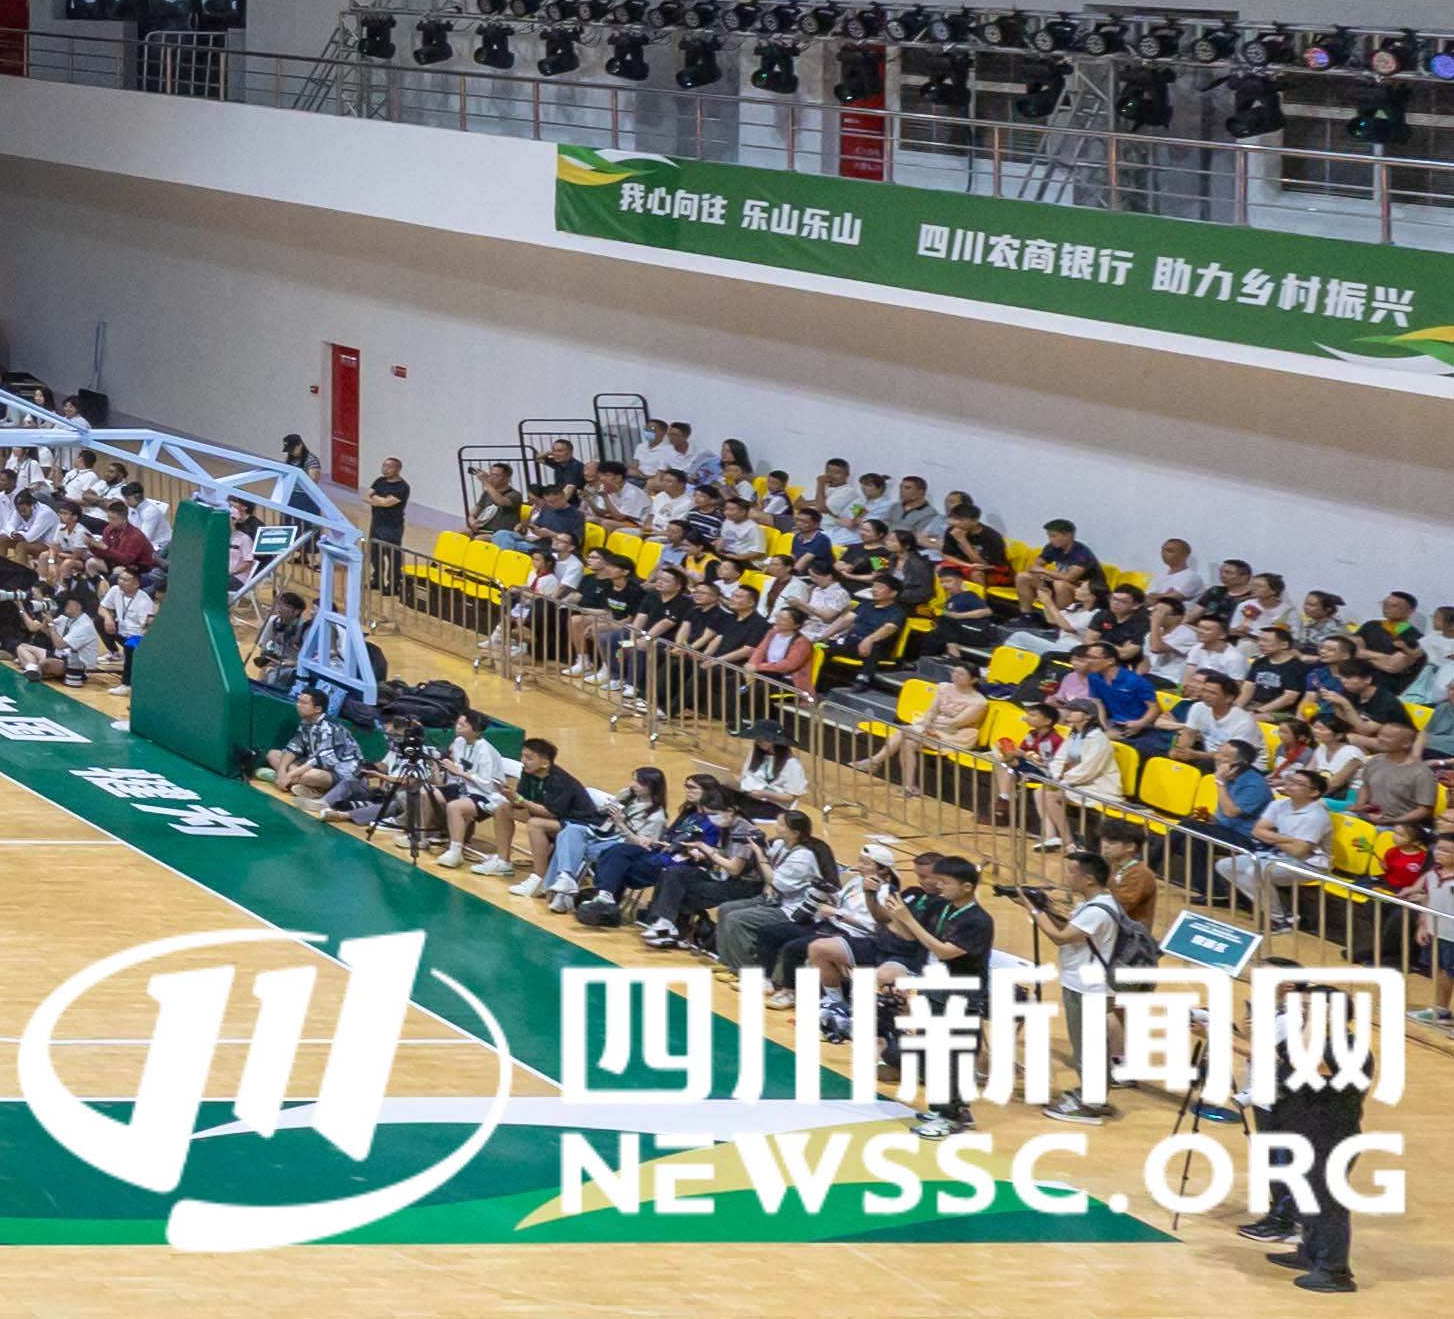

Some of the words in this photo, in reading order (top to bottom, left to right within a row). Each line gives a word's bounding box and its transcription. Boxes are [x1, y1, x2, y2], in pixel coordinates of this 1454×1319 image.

[618, 181, 728, 226] 我心向往
[740, 198, 863, 247] 乐山乐山
[916, 222, 1135, 287] 四川农商银行
[1151, 254, 1415, 329] 助力乡村振兴
[68, 767, 261, 838] 犍为
